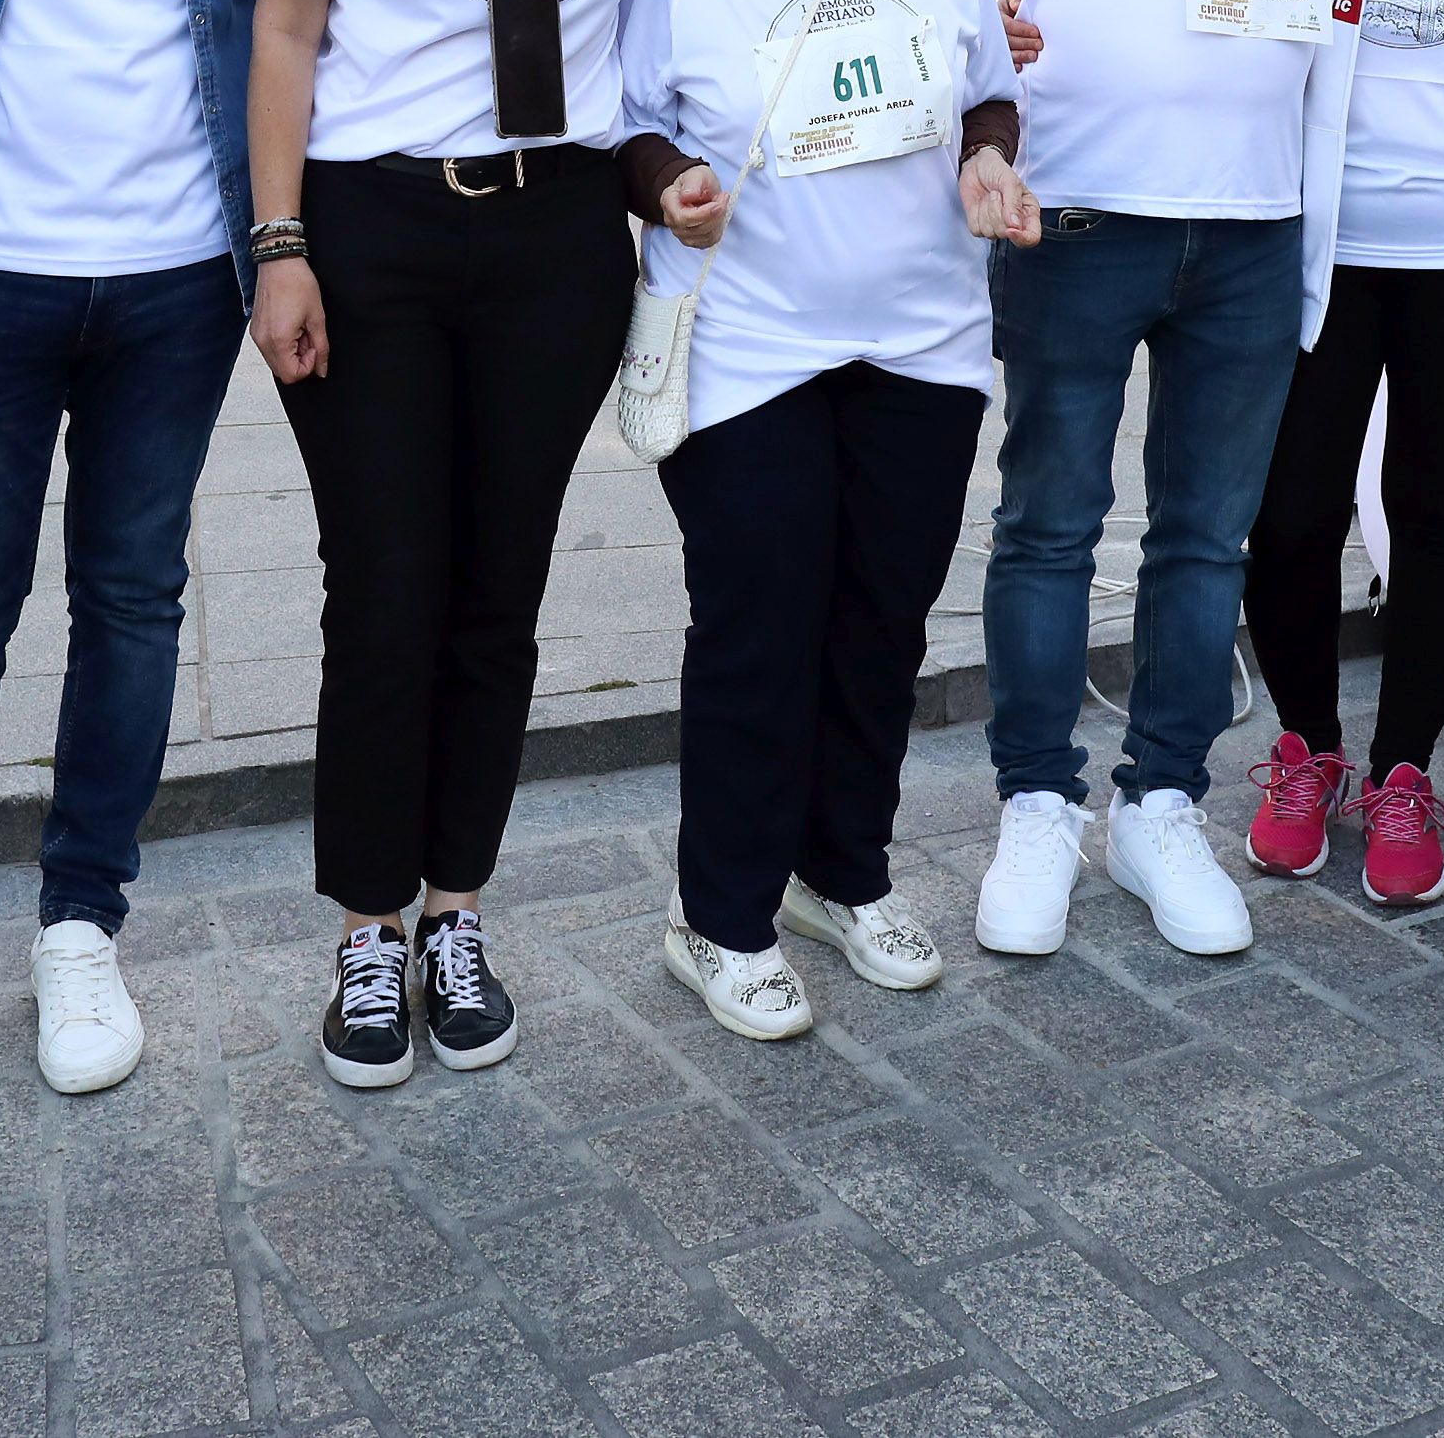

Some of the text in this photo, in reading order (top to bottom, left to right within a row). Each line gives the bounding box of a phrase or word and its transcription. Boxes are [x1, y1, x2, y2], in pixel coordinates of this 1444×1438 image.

[803, 5, 875, 25] IPRIANO
[910, 35, 931, 82] MARCHA
[833, 55, 883, 103] 611
[808, 99, 914, 126] JOSEFA PUÑAL ARIZA
[793, 136, 852, 156] CIPRIANO
